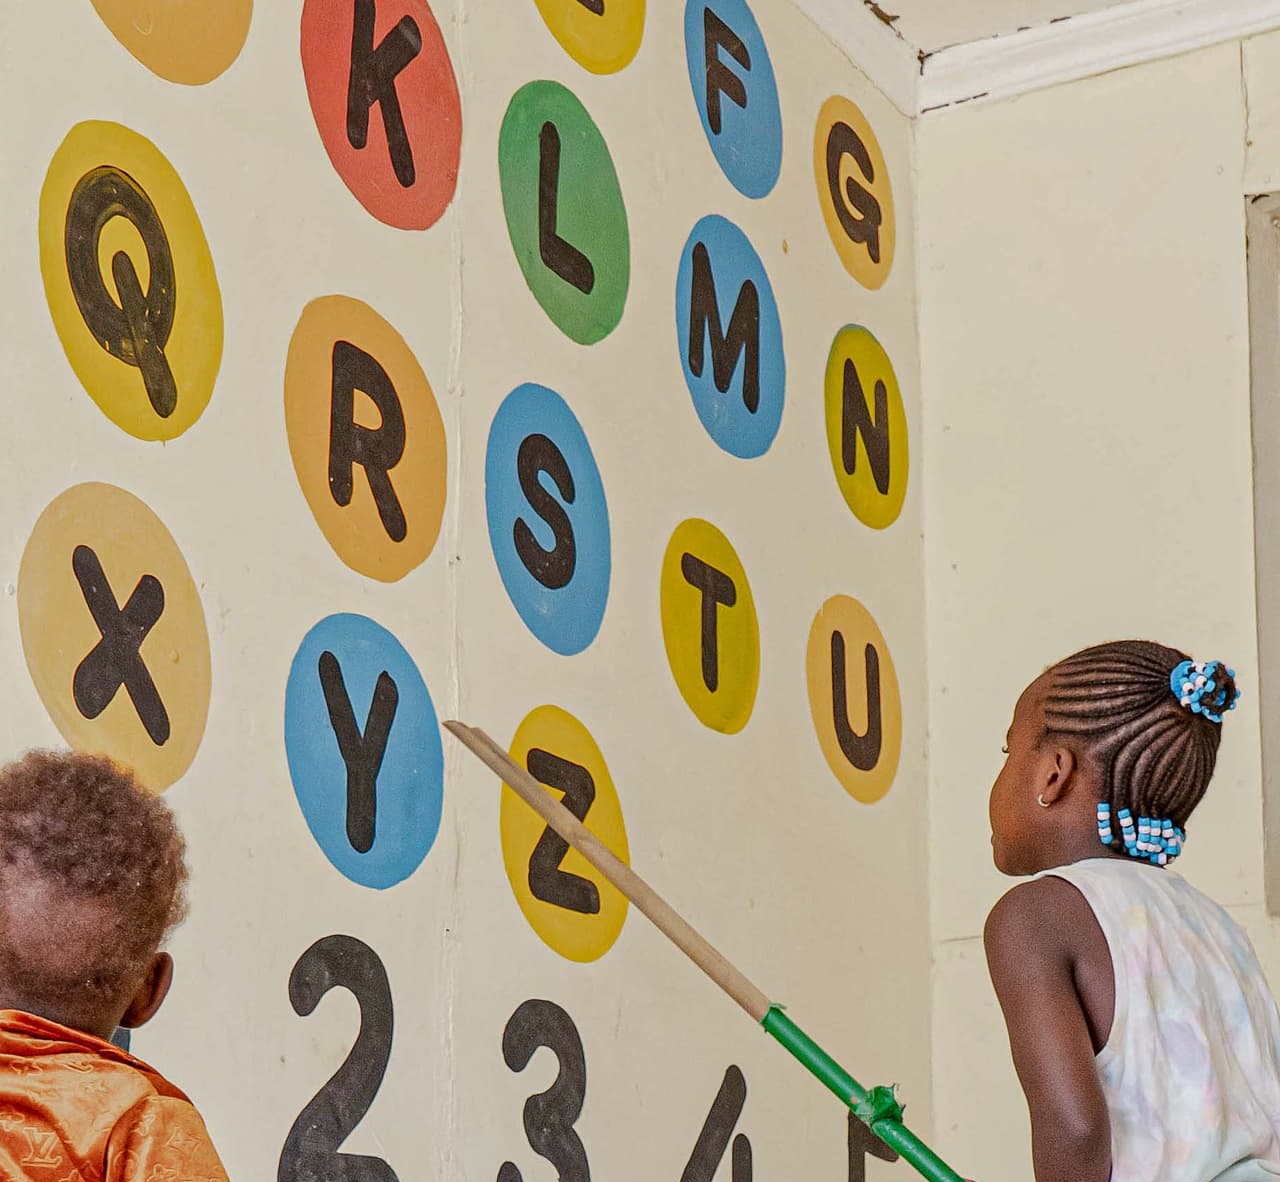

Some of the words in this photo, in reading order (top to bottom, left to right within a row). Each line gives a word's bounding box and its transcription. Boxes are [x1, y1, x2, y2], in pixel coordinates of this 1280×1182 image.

[347, 0, 421, 187] K
[538, 121, 595, 295] L
[688, 241, 760, 414] M
[842, 358, 889, 495] N
[704, 7, 751, 135] F
[827, 122, 881, 263] G
[65, 165, 177, 418] Q
[329, 341, 406, 542] R
[513, 434, 576, 590] S
[681, 553, 738, 695] T
[831, 631, 881, 771] U
[73, 545, 170, 746] X
[318, 651, 399, 853] Y
[527, 748, 600, 915] Z
